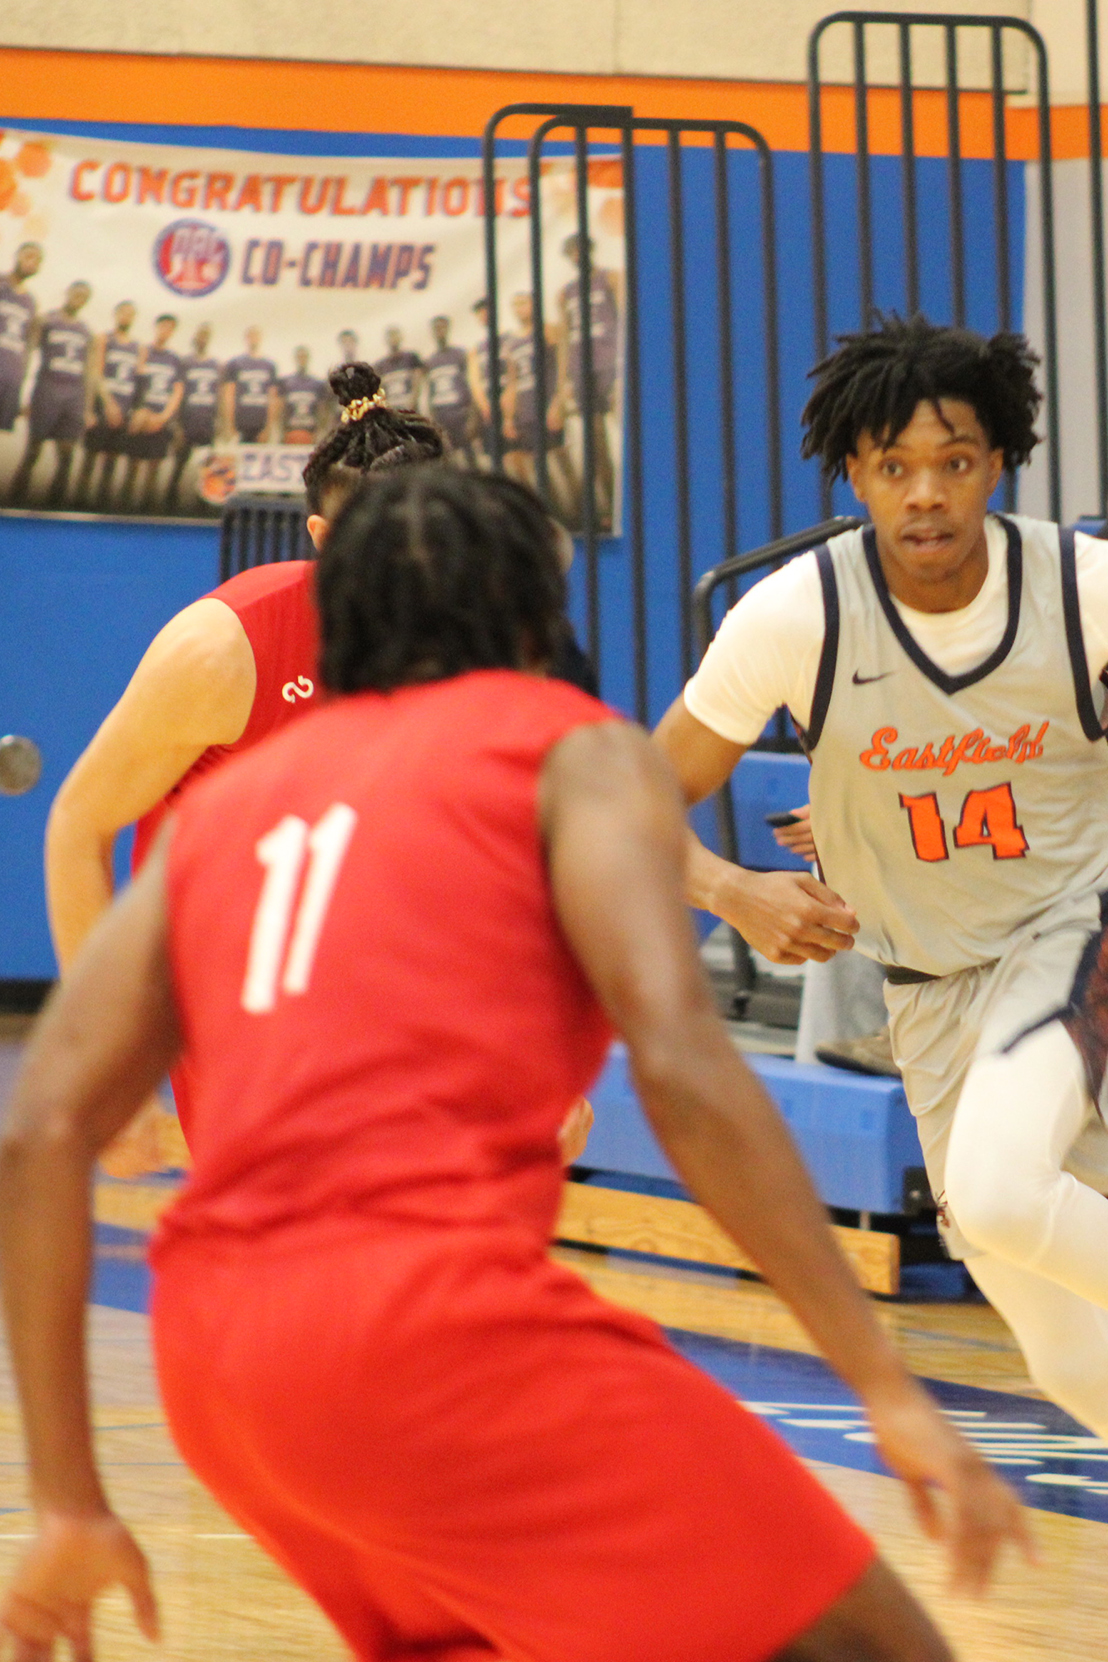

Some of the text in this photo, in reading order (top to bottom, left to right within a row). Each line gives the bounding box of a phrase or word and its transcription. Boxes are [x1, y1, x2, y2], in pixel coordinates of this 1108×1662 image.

[69, 160, 531, 217] CONGRATULATIONS
[242, 238, 436, 290] CO-CHAMPS
[859, 720, 1050, 777] Eastfield
[898, 781, 1030, 863] 14
[240, 802, 358, 1014] 11
